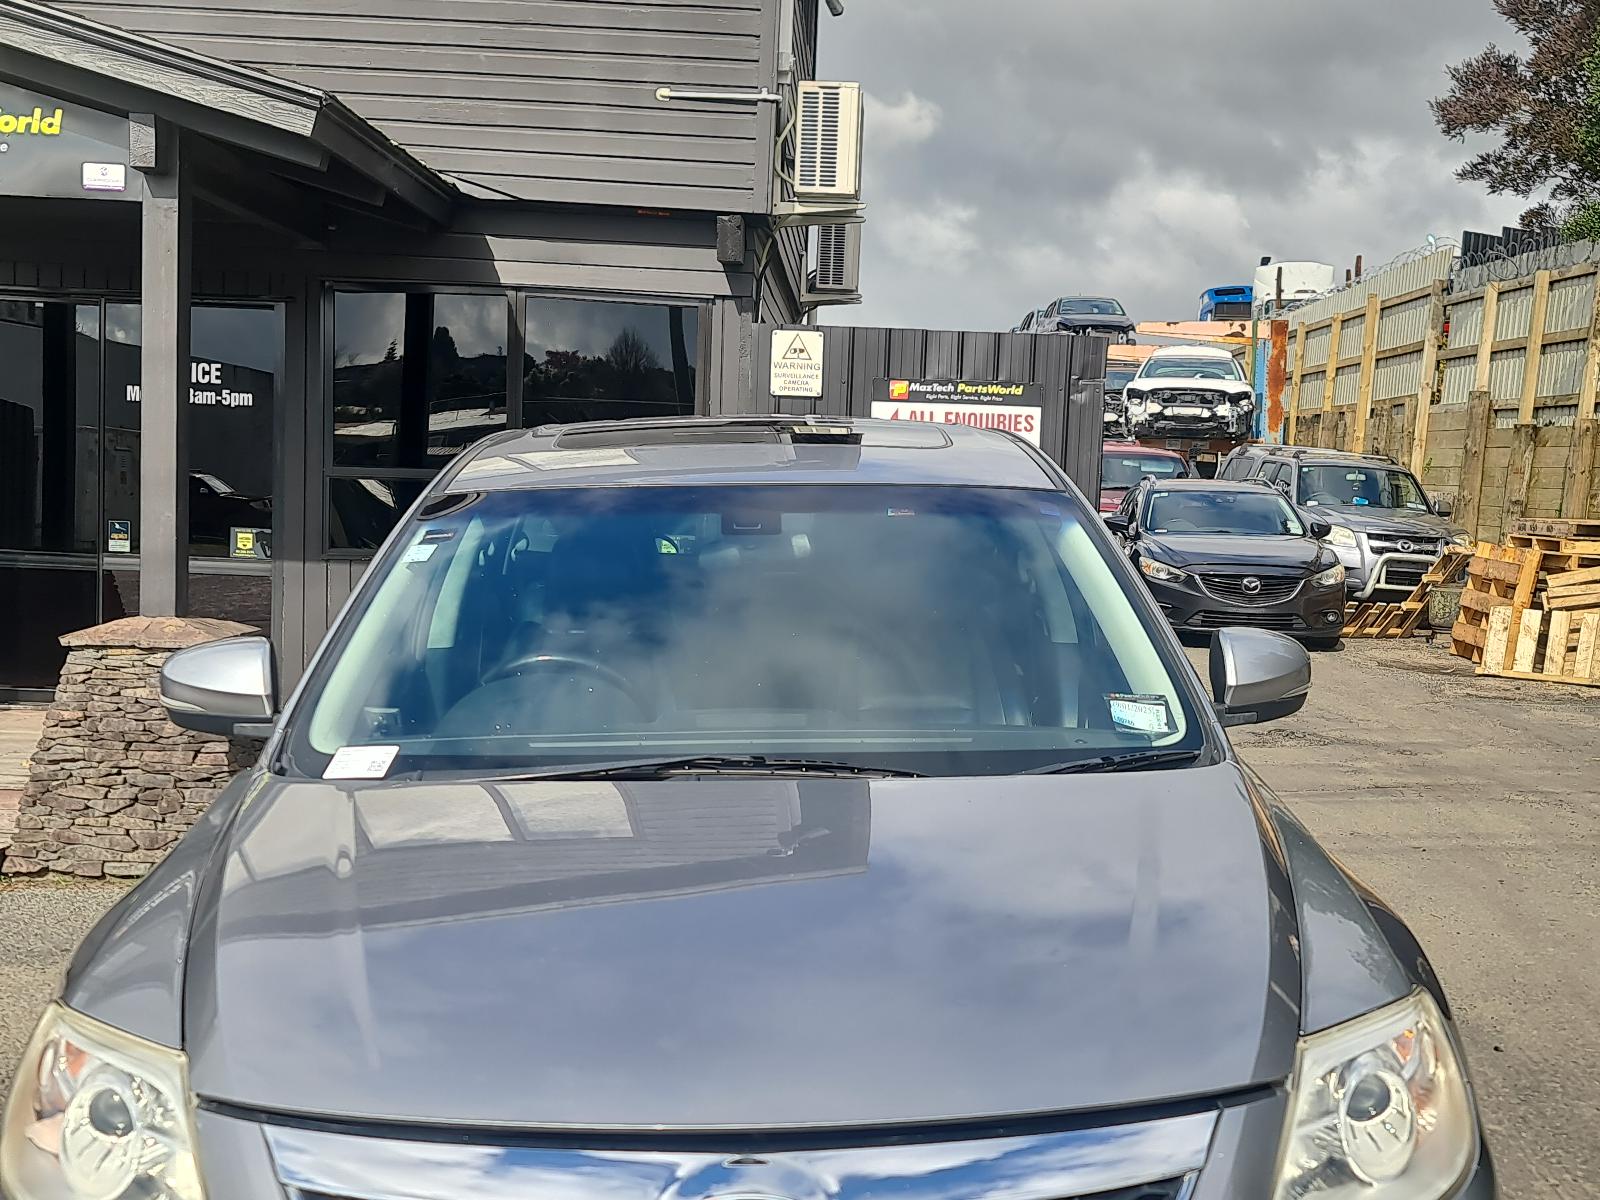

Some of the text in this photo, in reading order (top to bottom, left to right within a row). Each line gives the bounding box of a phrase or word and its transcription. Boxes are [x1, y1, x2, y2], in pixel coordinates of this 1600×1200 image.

[0, 107, 63, 135] orld
[190, 362, 222, 385] ICE
[773, 361, 821, 371] WARNING
[909, 382, 955, 393] MaxTech
[956, 383, 1024, 396] PartsWorld
